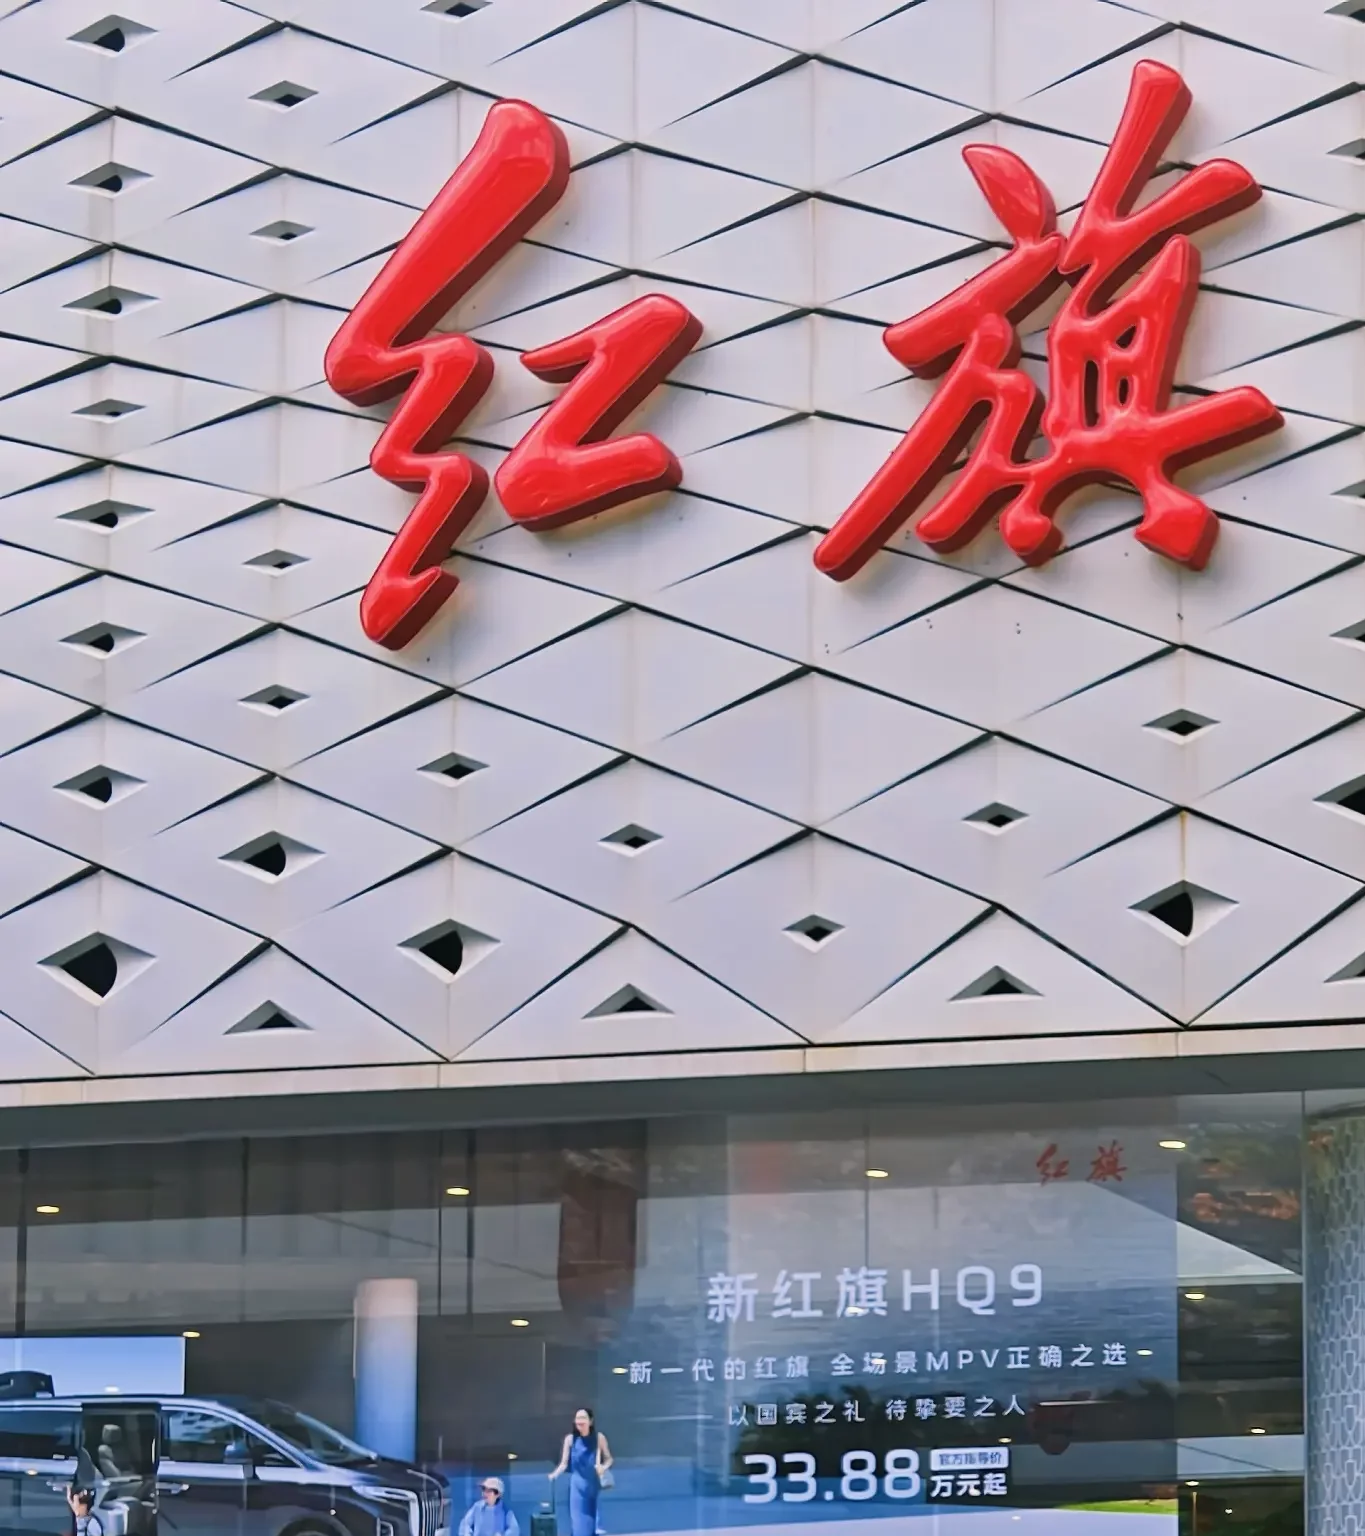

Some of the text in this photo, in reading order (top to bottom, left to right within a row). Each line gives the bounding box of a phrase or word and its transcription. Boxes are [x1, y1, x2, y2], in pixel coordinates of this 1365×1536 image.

[323, 58, 1284, 651] 红旗
[1036, 1140, 1128, 1187] 红旗
[707, 1264, 1042, 1323] 新红旗HQ9
[629, 1342, 1127, 1384] 新一代的红旗 全场景MPV正确之选
[743, 1449, 920, 1503] 33.88
[930, 1473, 1008, 1498] 万元起
